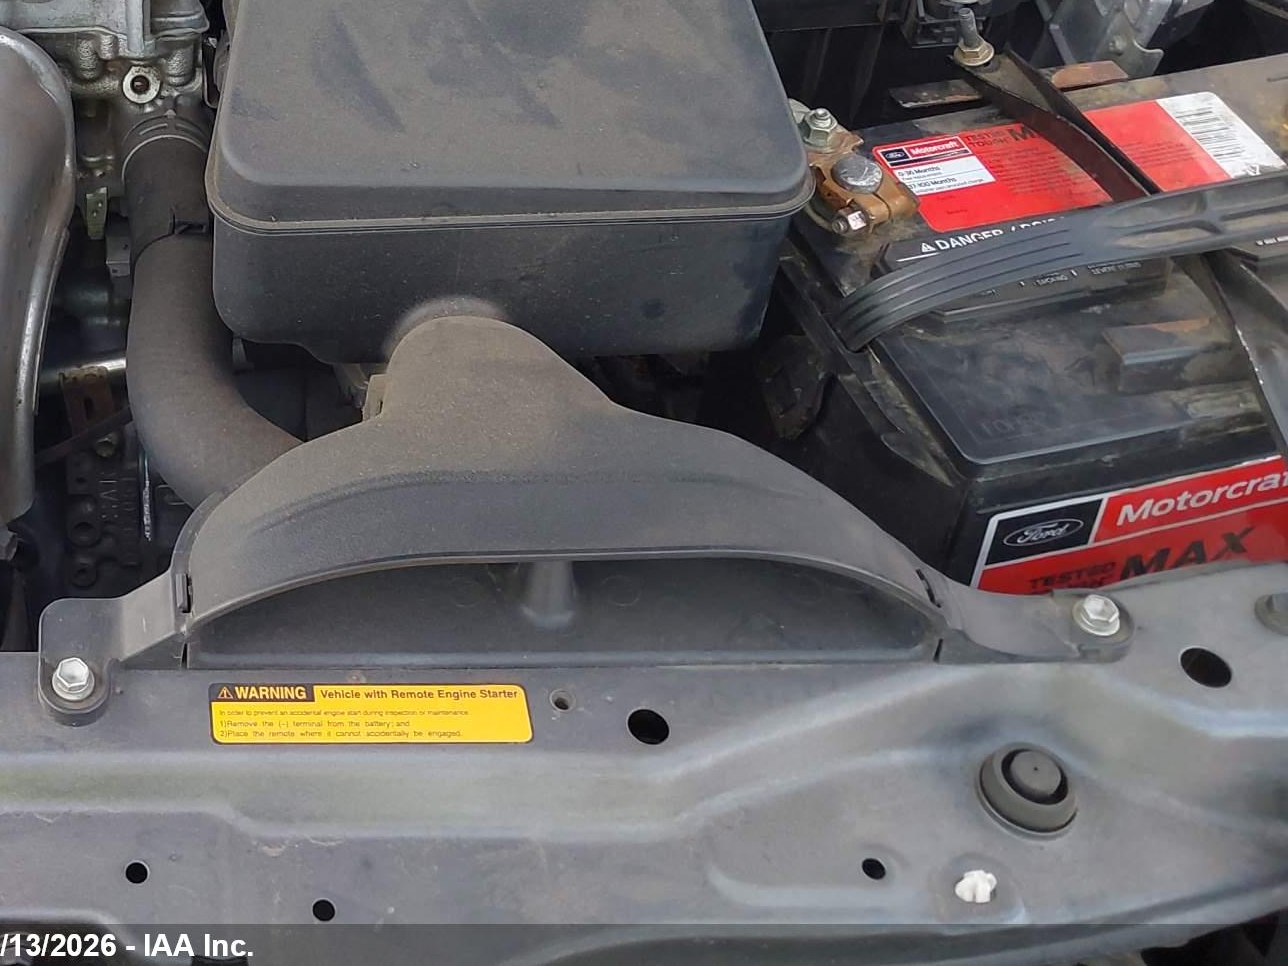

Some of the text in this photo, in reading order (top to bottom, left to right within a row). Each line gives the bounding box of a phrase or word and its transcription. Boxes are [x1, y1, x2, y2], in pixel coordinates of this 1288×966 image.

[909, 140, 960, 155] Motorcraft
[914, 166, 941, 174] Months
[930, 177, 958, 185] Months
[1014, 521, 1069, 545] Ford
[1119, 525, 1255, 581] MAX
[234, 685, 518, 701] WARNING Vehicle with Remote Engine Starter
[362, 710, 384, 718] during
[385, 709, 418, 717] inspection
[366, 730, 410, 738] accidentally
